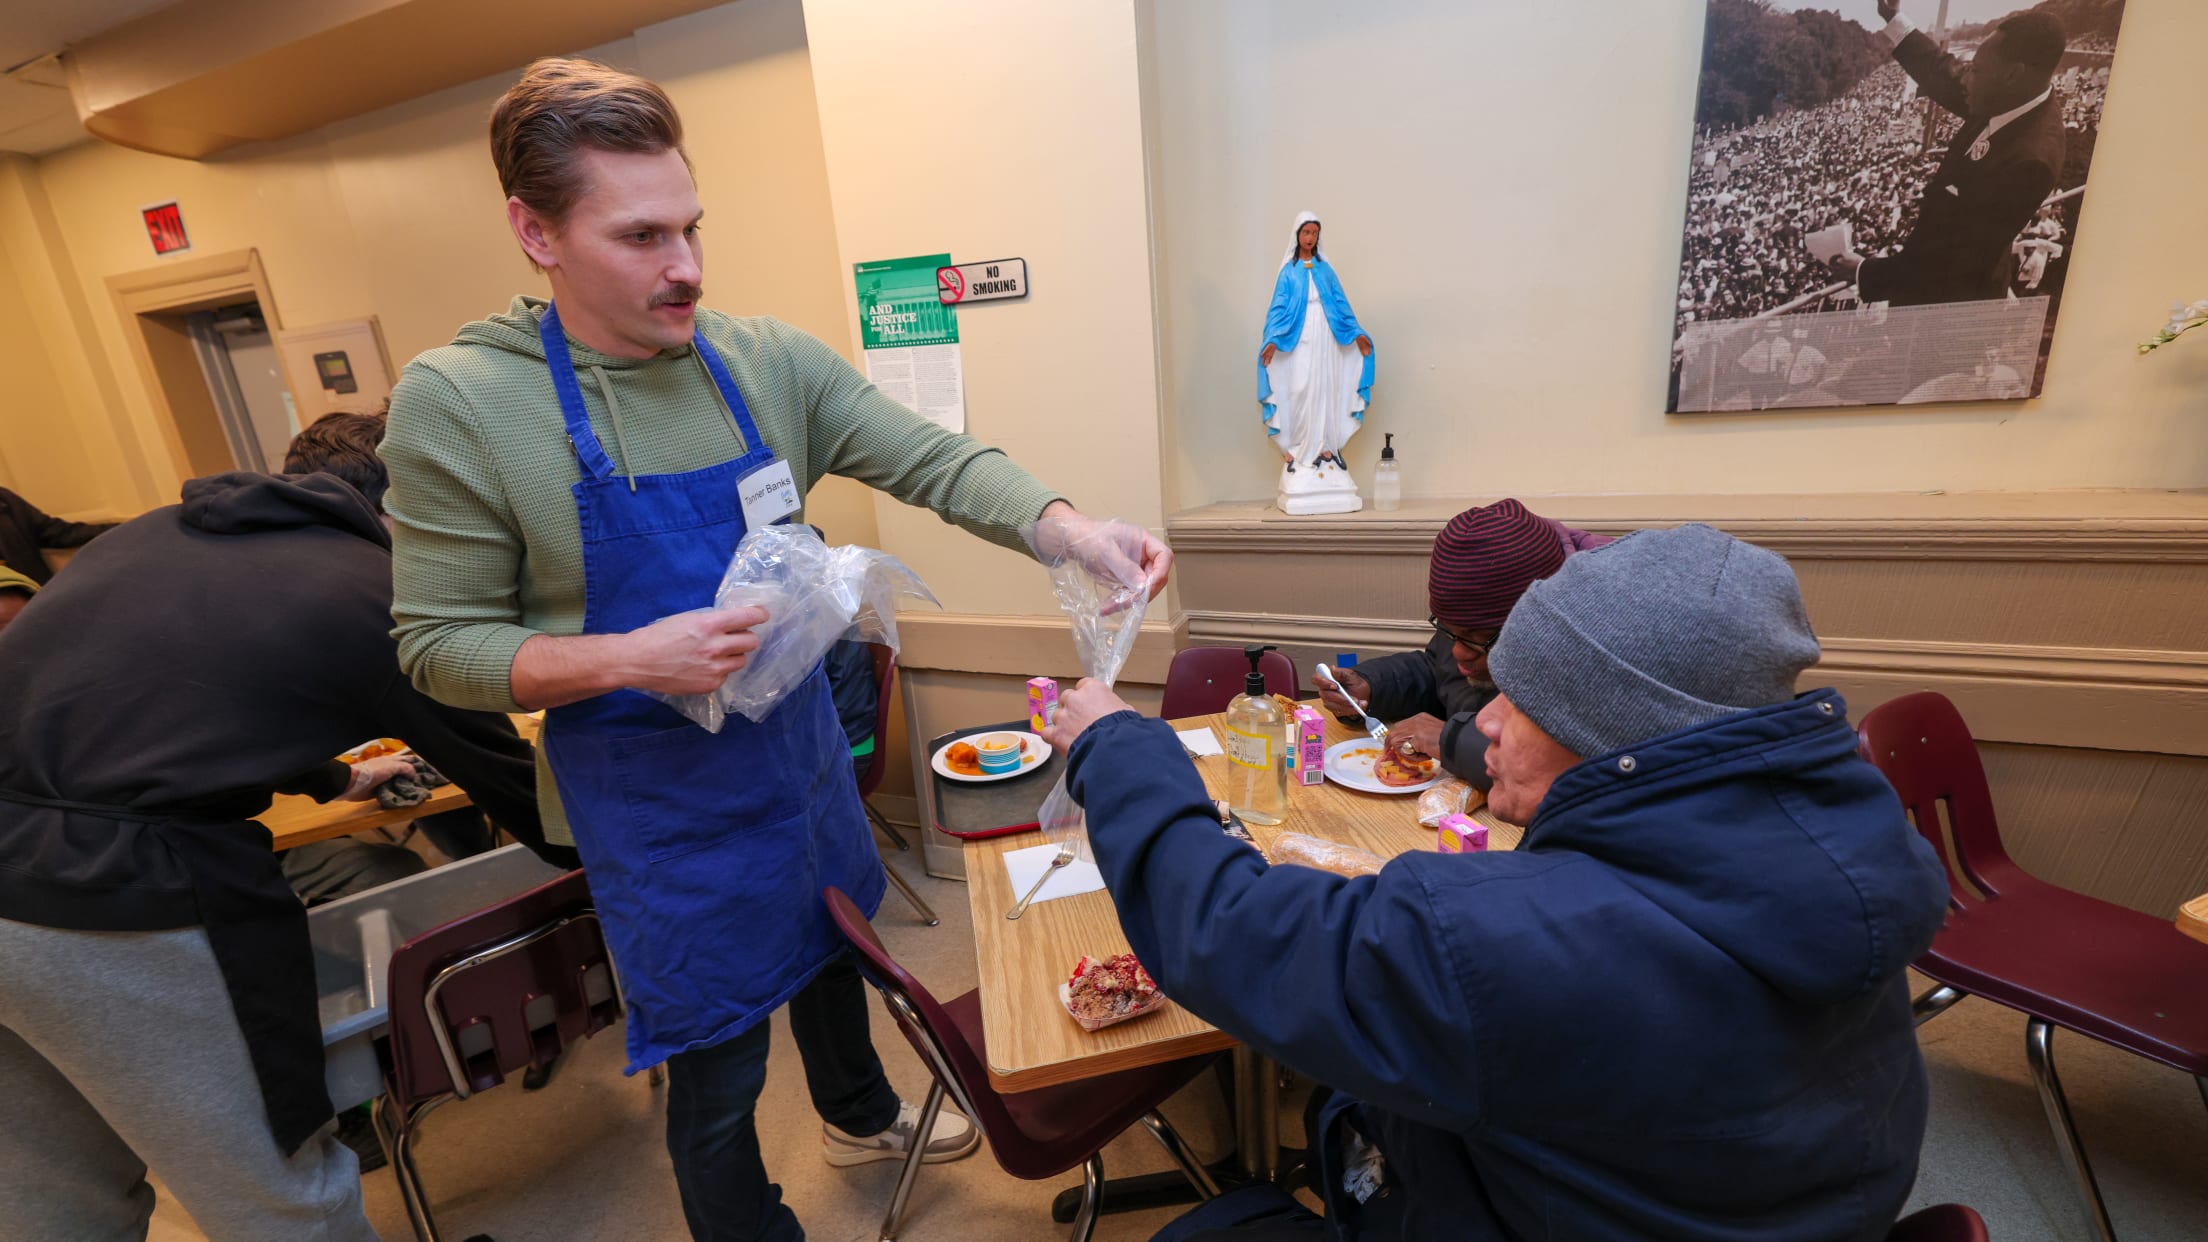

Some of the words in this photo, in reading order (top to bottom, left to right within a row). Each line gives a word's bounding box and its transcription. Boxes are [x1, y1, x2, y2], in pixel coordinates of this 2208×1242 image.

[144, 206, 187, 251] EXIT
[986, 265, 999, 278] NO
[972, 279, 1017, 295] SMOKING
[869, 304, 893, 315] AND
[870, 313, 917, 326] JUSTICE
[884, 324, 905, 335] ALL
[765, 477, 791, 494] Banks
